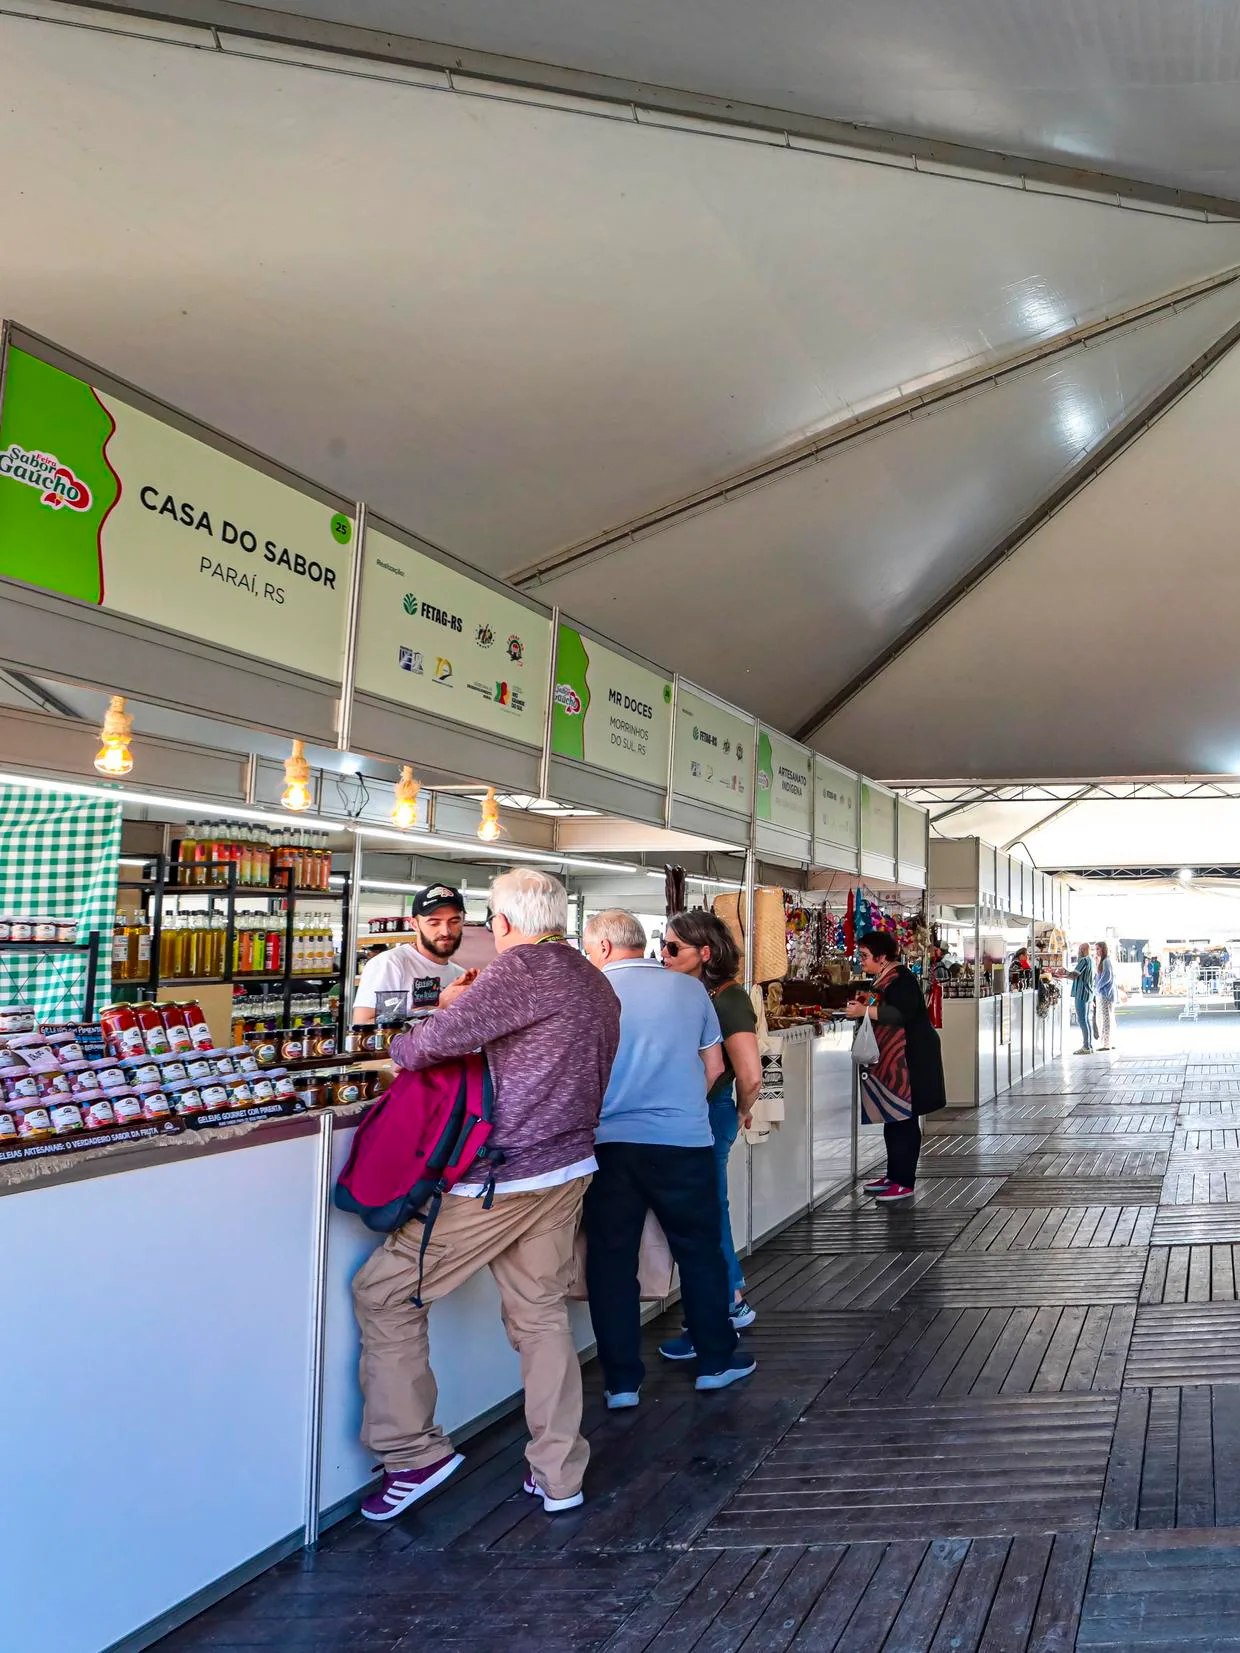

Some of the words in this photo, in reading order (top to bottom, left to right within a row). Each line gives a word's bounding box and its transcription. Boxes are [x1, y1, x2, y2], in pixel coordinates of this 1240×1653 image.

[10, 447, 57, 473] Sabor
[0, 454, 79, 500] Gaúcho
[140, 486, 213, 537] CASA
[222, 521, 257, 553] DO
[263, 541, 337, 590] SABOR
[335, 521, 347, 535] 25
[200, 556, 259, 598] PARAÍ,
[264, 583, 286, 605] RS
[421, 602, 463, 632] FETAG-RS
[608, 688, 622, 706] MR
[624, 696, 653, 719] DOCES
[610, 716, 649, 740] MORRINHOS
[610, 733, 621, 746] DO
[778, 766, 807, 786] ARTESANATO
[0, 1150, 23, 1161] ELEIAS
[72, 1136, 111, 1148] VERDADEIRO
[111, 1132, 131, 1142] SABOR
[131, 1130, 141, 1138] DA
[141, 1127, 159, 1137] FRUTA
